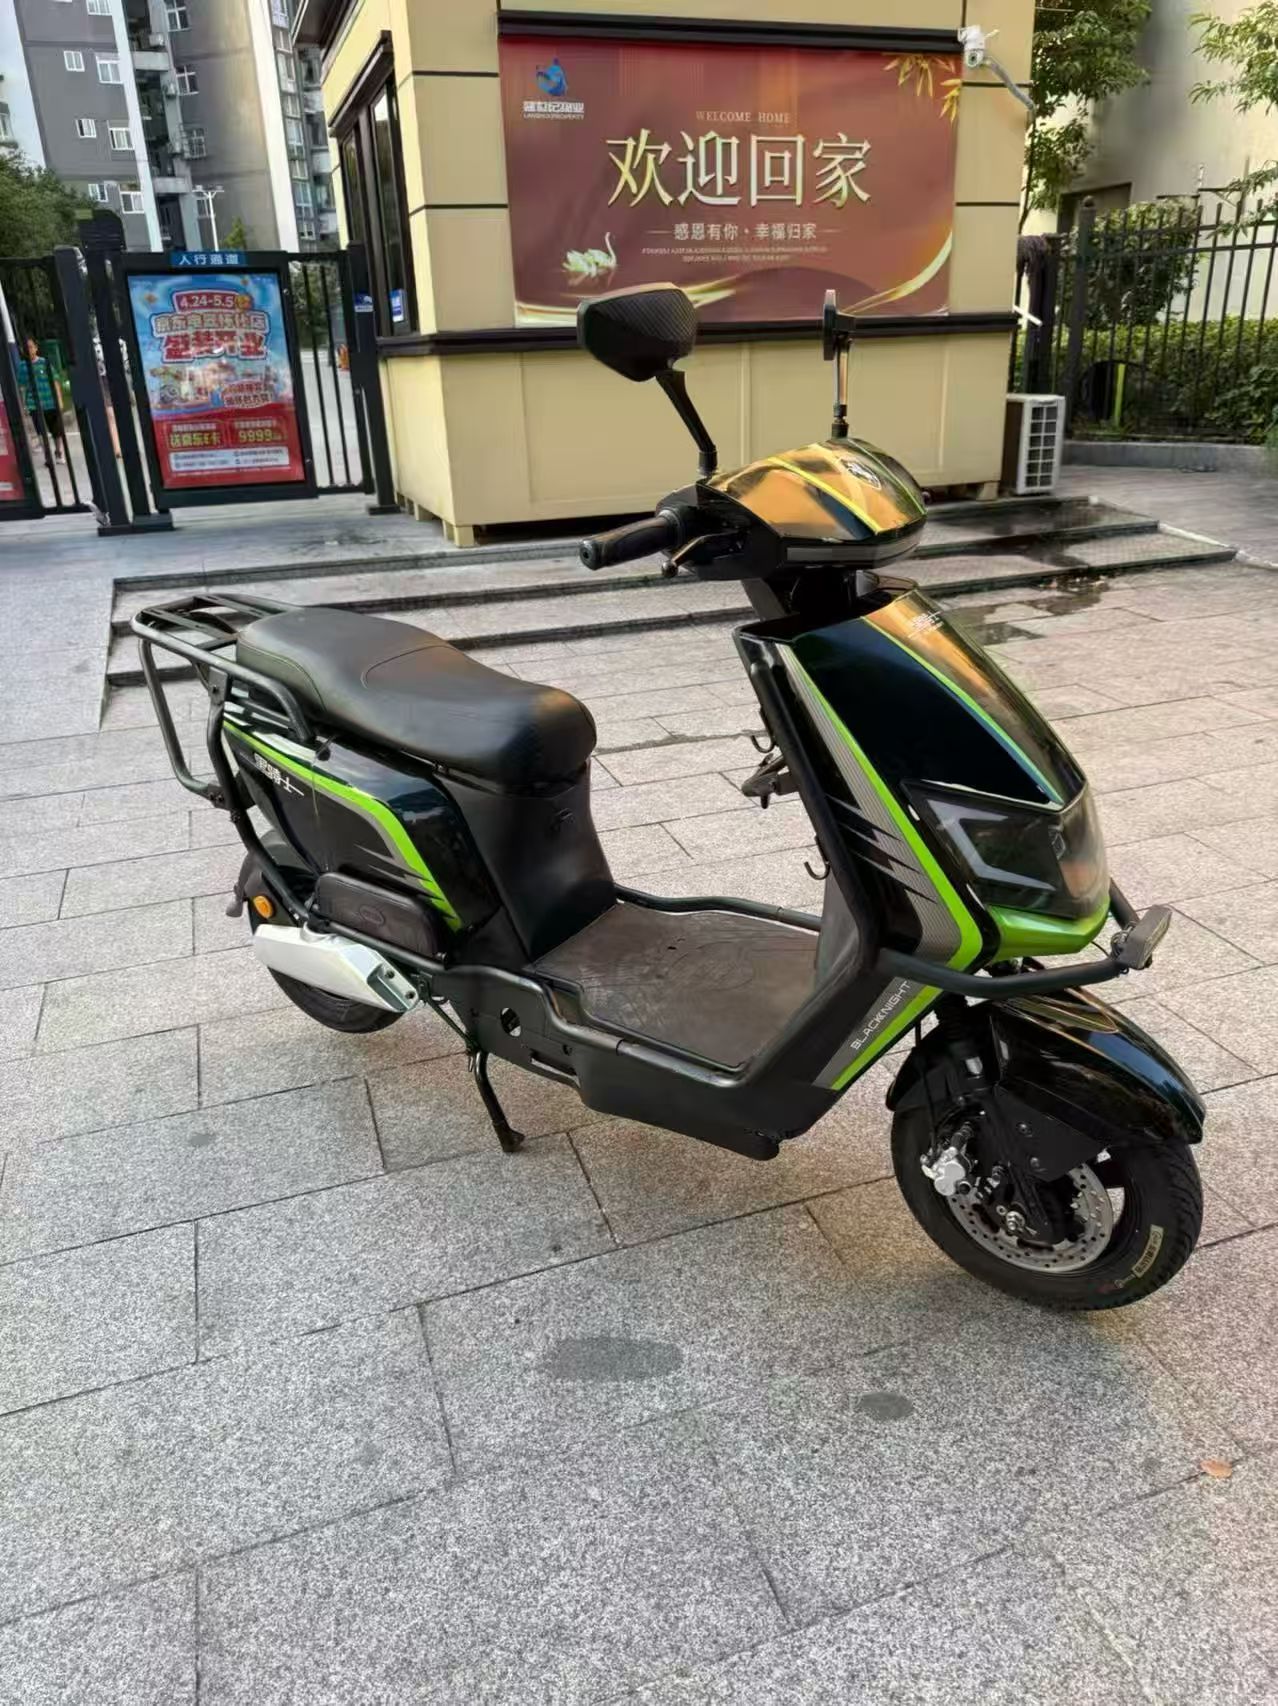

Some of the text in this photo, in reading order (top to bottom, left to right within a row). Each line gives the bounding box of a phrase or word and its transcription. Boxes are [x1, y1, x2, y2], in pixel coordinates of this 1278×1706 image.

[696, 111, 791, 123] WELCOME HOME
[605, 127, 872, 208] 欢迎回家
[178, 253, 239, 266] 人行通道
[180, 294, 235, 308] 4.24-5.5
